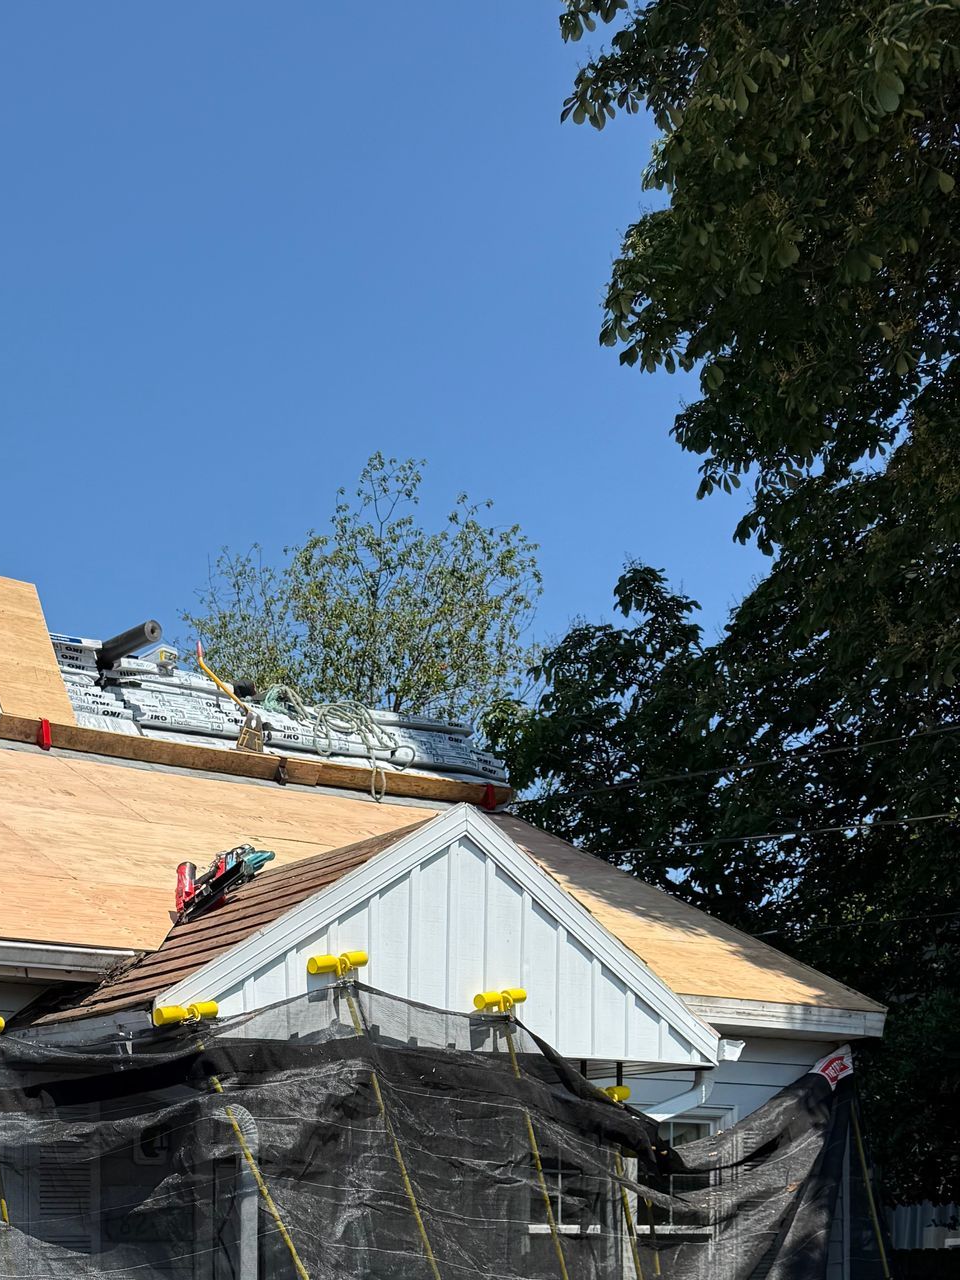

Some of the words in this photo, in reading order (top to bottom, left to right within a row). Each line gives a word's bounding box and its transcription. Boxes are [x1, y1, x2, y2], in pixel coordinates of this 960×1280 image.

[65, 646, 83, 654] IKO
[61, 654, 79, 662] IKO
[102, 709, 122, 719] IKO
[150, 714, 168, 722] IKO
[283, 733, 300, 741] IKO
[482, 766, 497, 774] IKO
